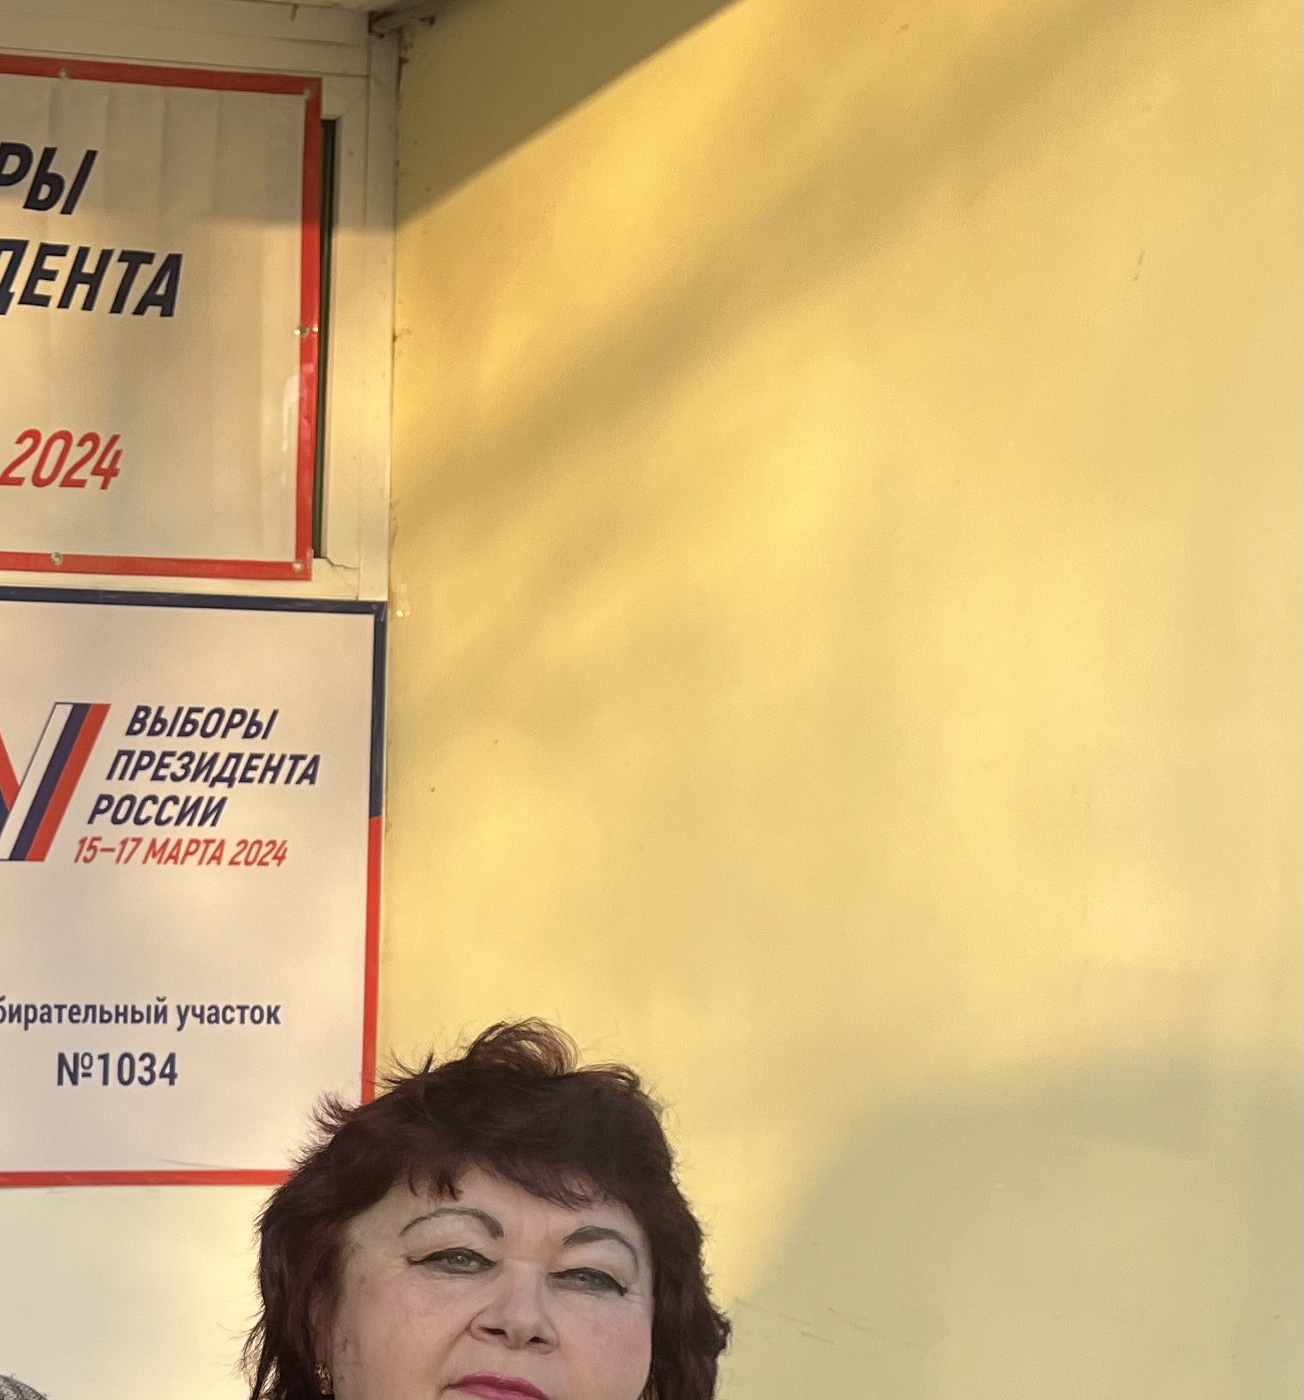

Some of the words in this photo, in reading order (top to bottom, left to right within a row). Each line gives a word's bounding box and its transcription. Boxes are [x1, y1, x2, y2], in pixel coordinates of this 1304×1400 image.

[125, 704, 280, 741] ВЫБОРЫ
[105, 749, 321, 788] ПРЕЗИДЕНТА
[87, 793, 229, 828] РОССИИ
[72, 835, 144, 865] 15–17
[142, 837, 227, 867] МАРТА
[227, 838, 288, 868] 2024
[175, 1000, 282, 1032] участок
[56, 1051, 179, 1088] №1034
